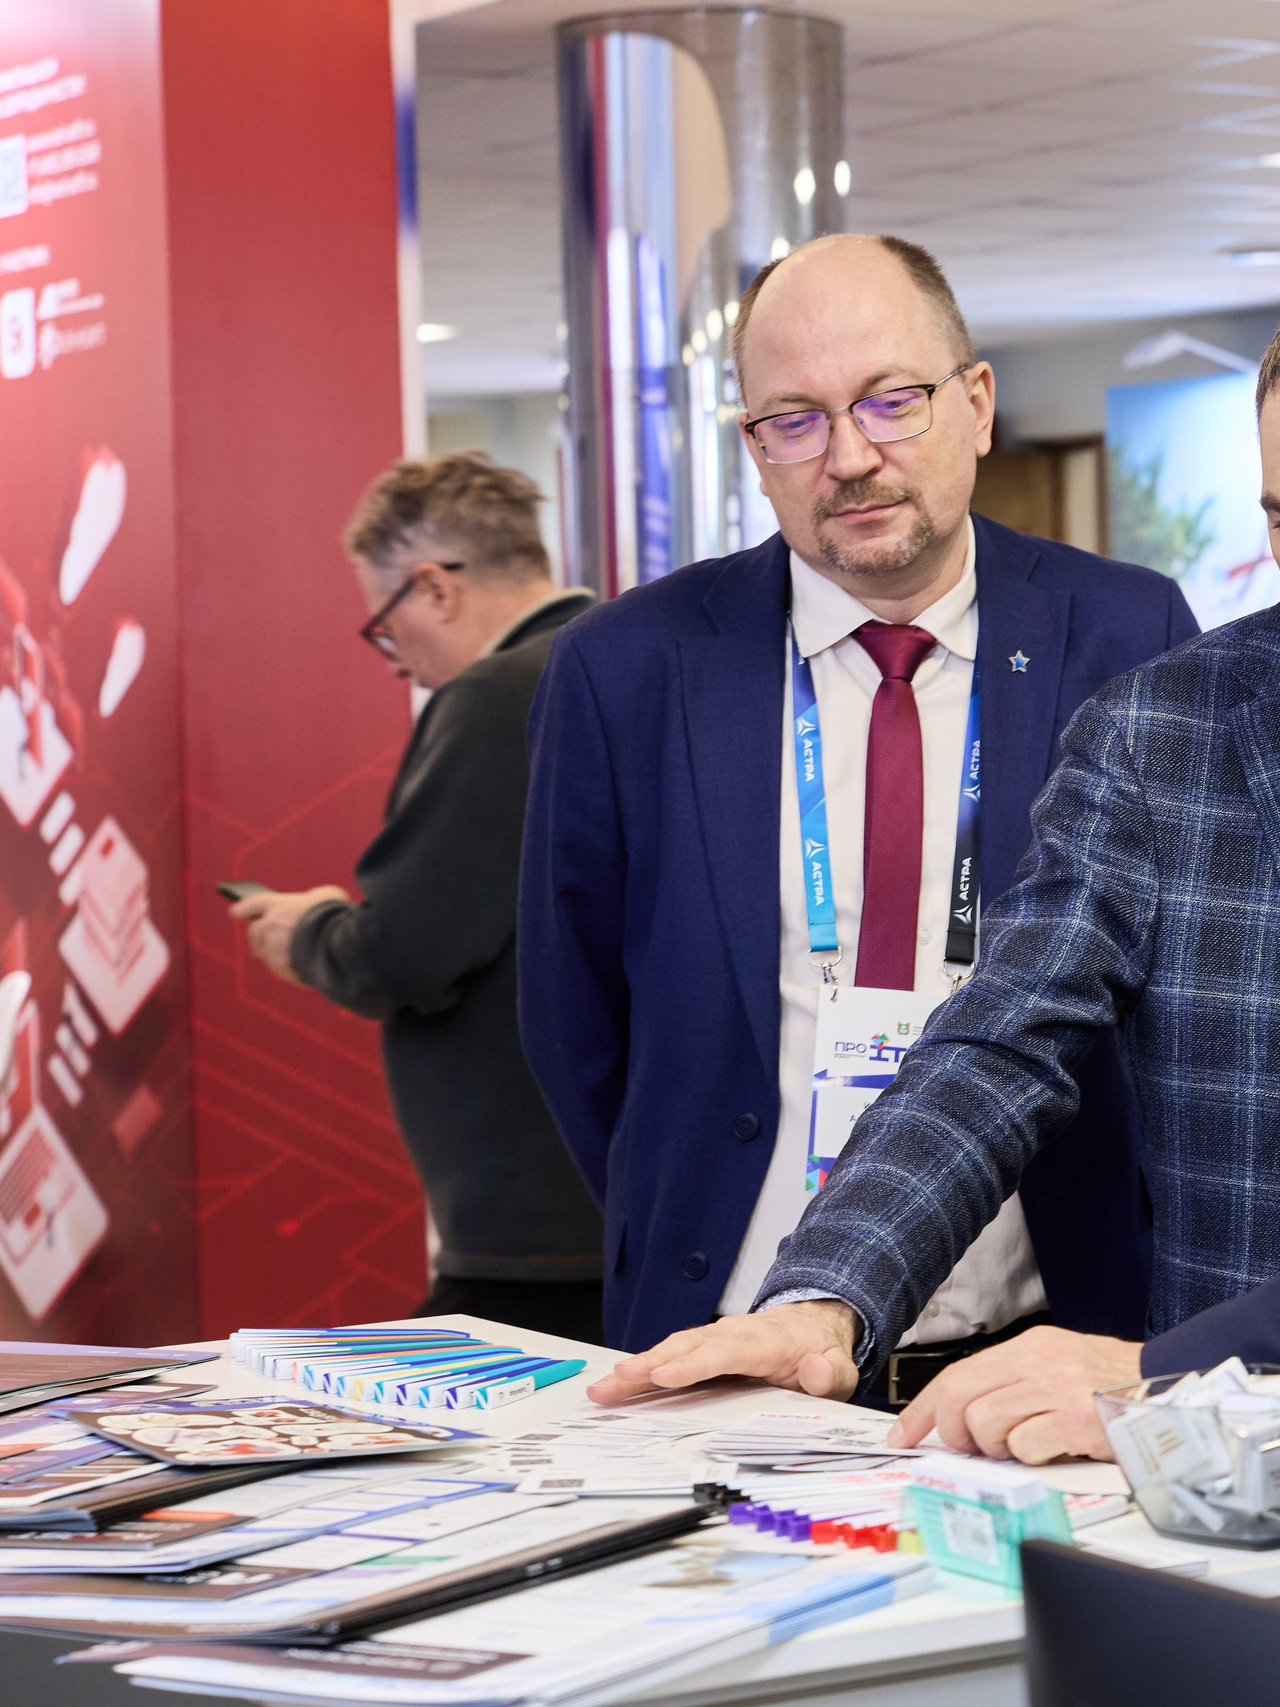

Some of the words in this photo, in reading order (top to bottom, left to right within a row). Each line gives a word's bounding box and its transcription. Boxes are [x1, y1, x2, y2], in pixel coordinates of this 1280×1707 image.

[803, 739, 815, 782] АСТРА
[811, 861, 825, 906] АСТРА
[959, 857, 972, 901] АСТРА
[835, 1041, 867, 1054] ПРО
